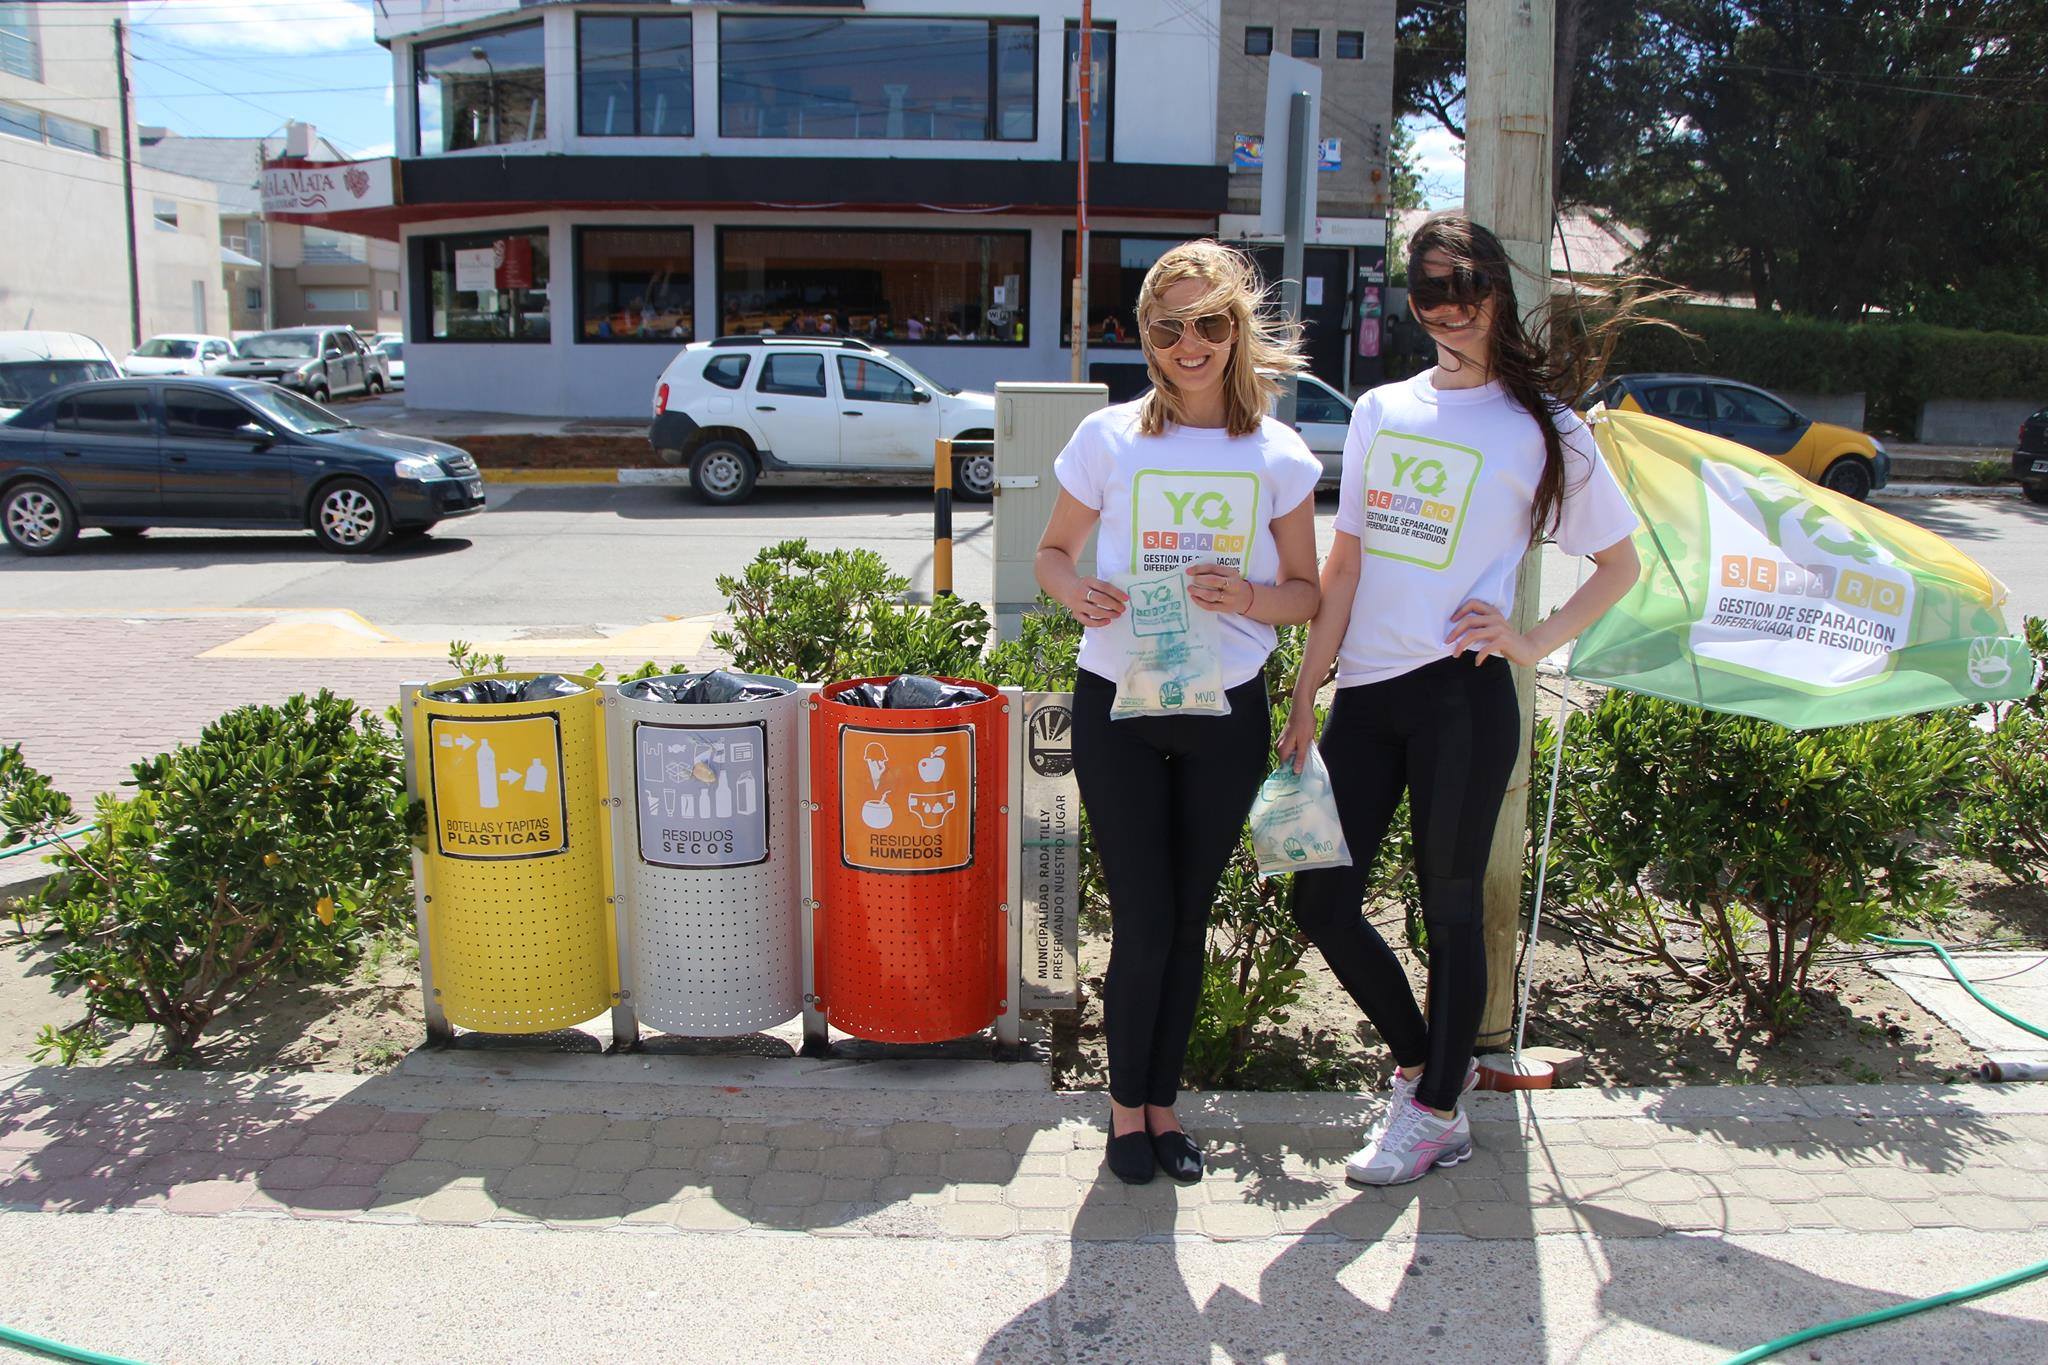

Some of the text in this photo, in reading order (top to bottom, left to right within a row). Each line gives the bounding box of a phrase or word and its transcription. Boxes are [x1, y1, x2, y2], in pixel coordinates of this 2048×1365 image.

[1367, 491, 1452, 520] SEPARO
[1389, 516, 1399, 525] DE
[1399, 517, 1449, 536] SEPARACION
[1145, 533, 1242, 549] SEPARO
[1401, 527, 1410, 536] DE
[1410, 529, 1447, 545] RESIDUOS
[1143, 554, 1180, 564] GESTION
[1725, 559, 1900, 610] SEPARO
[1718, 596, 1896, 643] GESTION DE SEPARACION
[1711, 614, 1893, 656] DIFERENCIADA DE RESIDUOS
[446, 817, 549, 833] BOTELLAS Y TAPITAS
[448, 830, 551, 845] PLASTICAS
[662, 829, 734, 842] RESIDUOS
[870, 833, 943, 847] RESIDUOS
[663, 841, 734, 854] SECOS
[870, 846, 943, 859] HUMEDOS
[1038, 809, 1050, 979] MUNICIPALIDAD RADA TILLY
[1053, 794, 1066, 980] PRESERVANDO NUESTRO LUGAR
